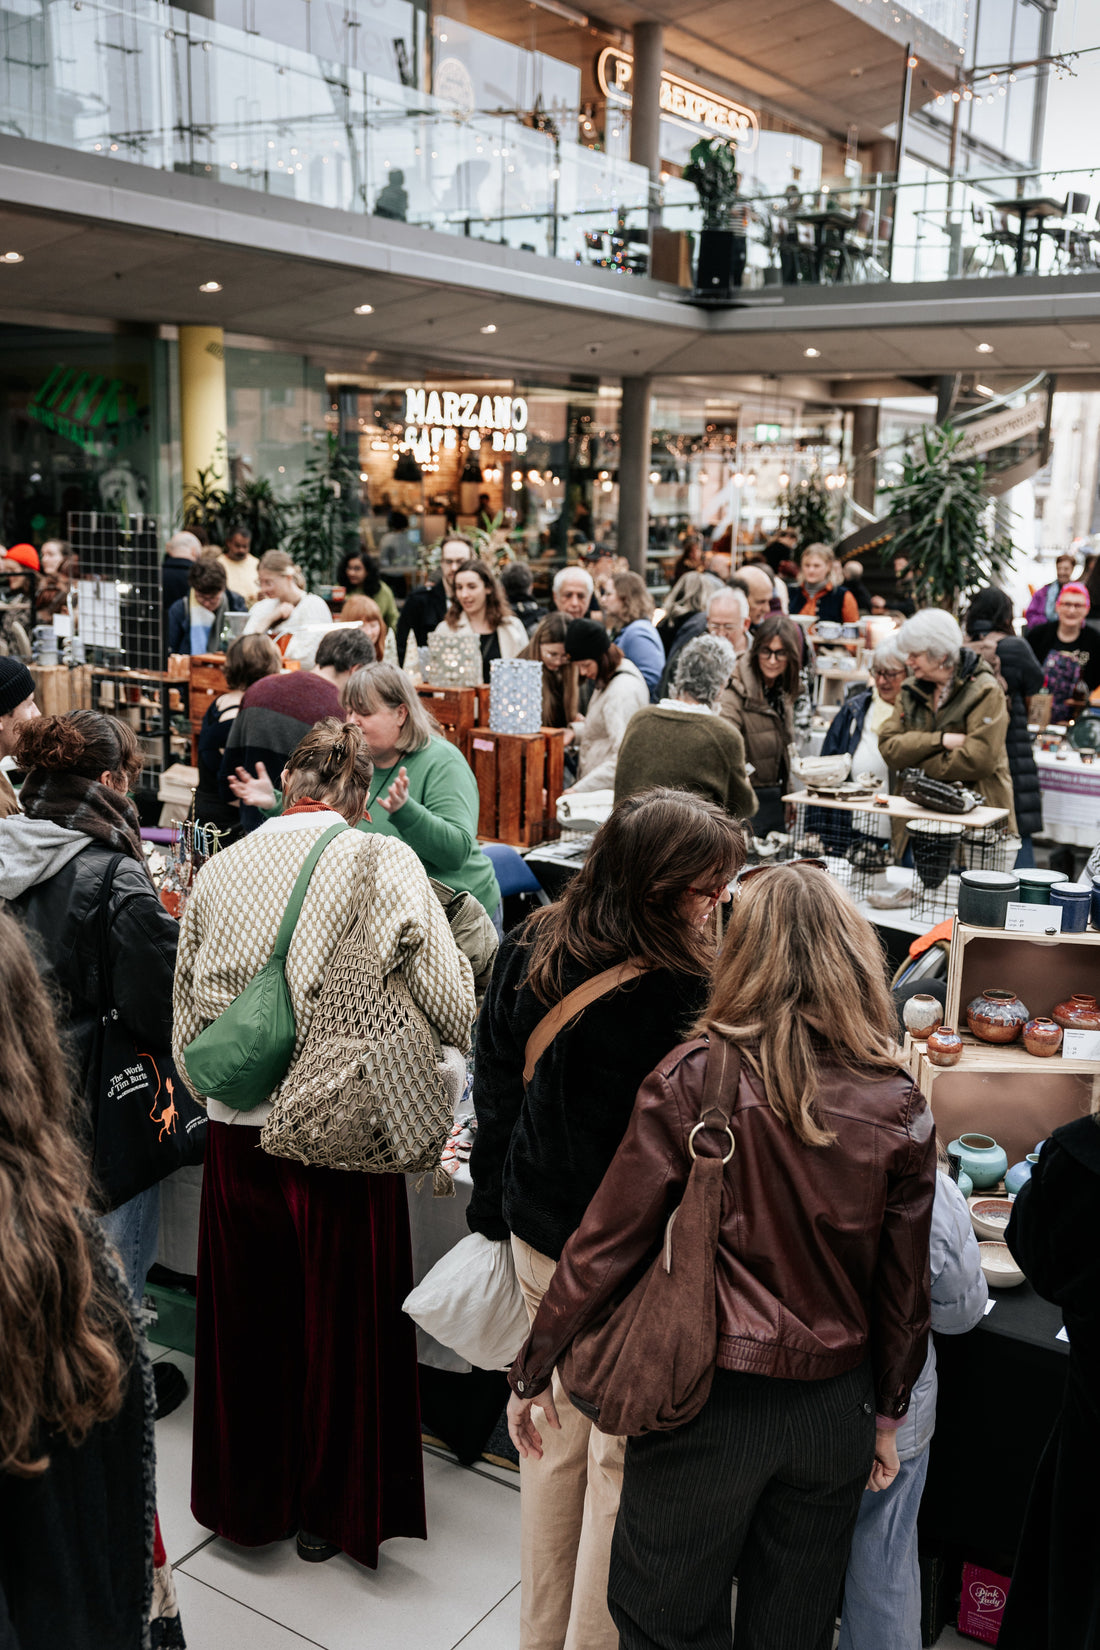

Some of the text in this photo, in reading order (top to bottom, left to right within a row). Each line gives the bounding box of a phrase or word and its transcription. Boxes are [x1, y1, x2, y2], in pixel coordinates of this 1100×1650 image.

[405, 388, 528, 431] MARZANO
[492, 431, 528, 452] BAR
[110, 1063, 144, 1086] The World
[107, 1086, 115, 1098] of
[114, 1080, 130, 1092] Tim
[975, 1588, 999, 1598] Pink
[979, 1596, 1000, 1606] Lady
